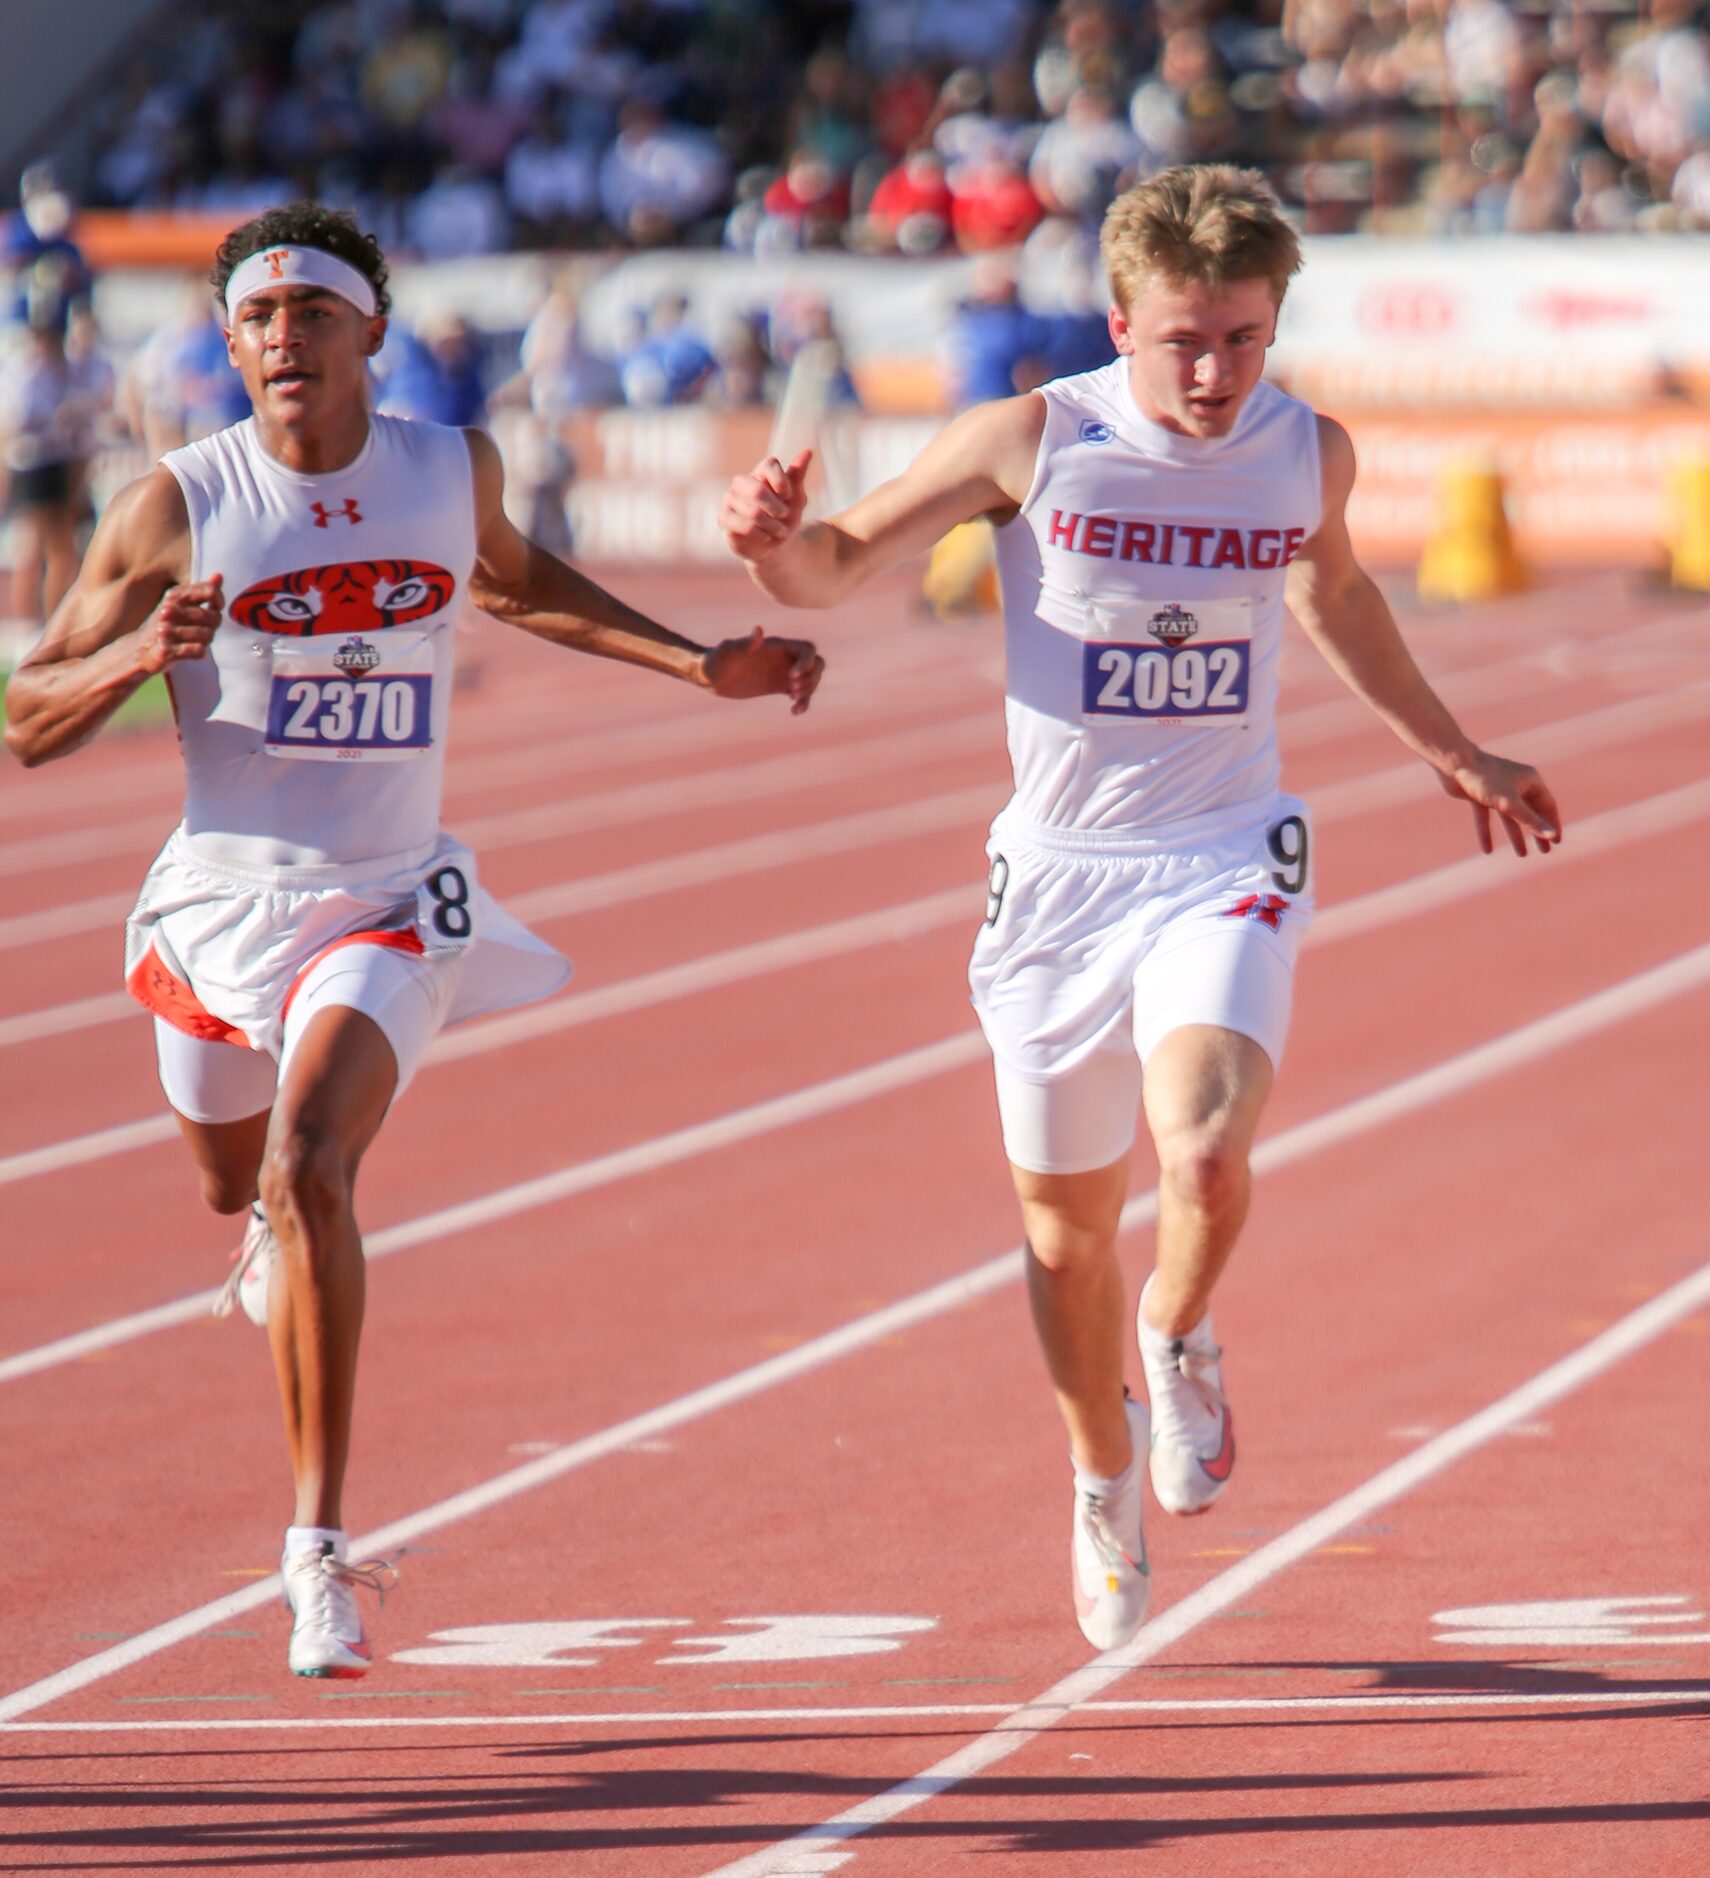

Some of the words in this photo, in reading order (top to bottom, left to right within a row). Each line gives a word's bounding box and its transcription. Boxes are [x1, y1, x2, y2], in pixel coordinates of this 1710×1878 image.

[1047, 509, 1305, 570] HERITAGE
[1096, 647, 1240, 710] 2092
[283, 681, 415, 741] 2370
[1266, 814, 1308, 895] 9
[426, 866, 471, 938] 8
